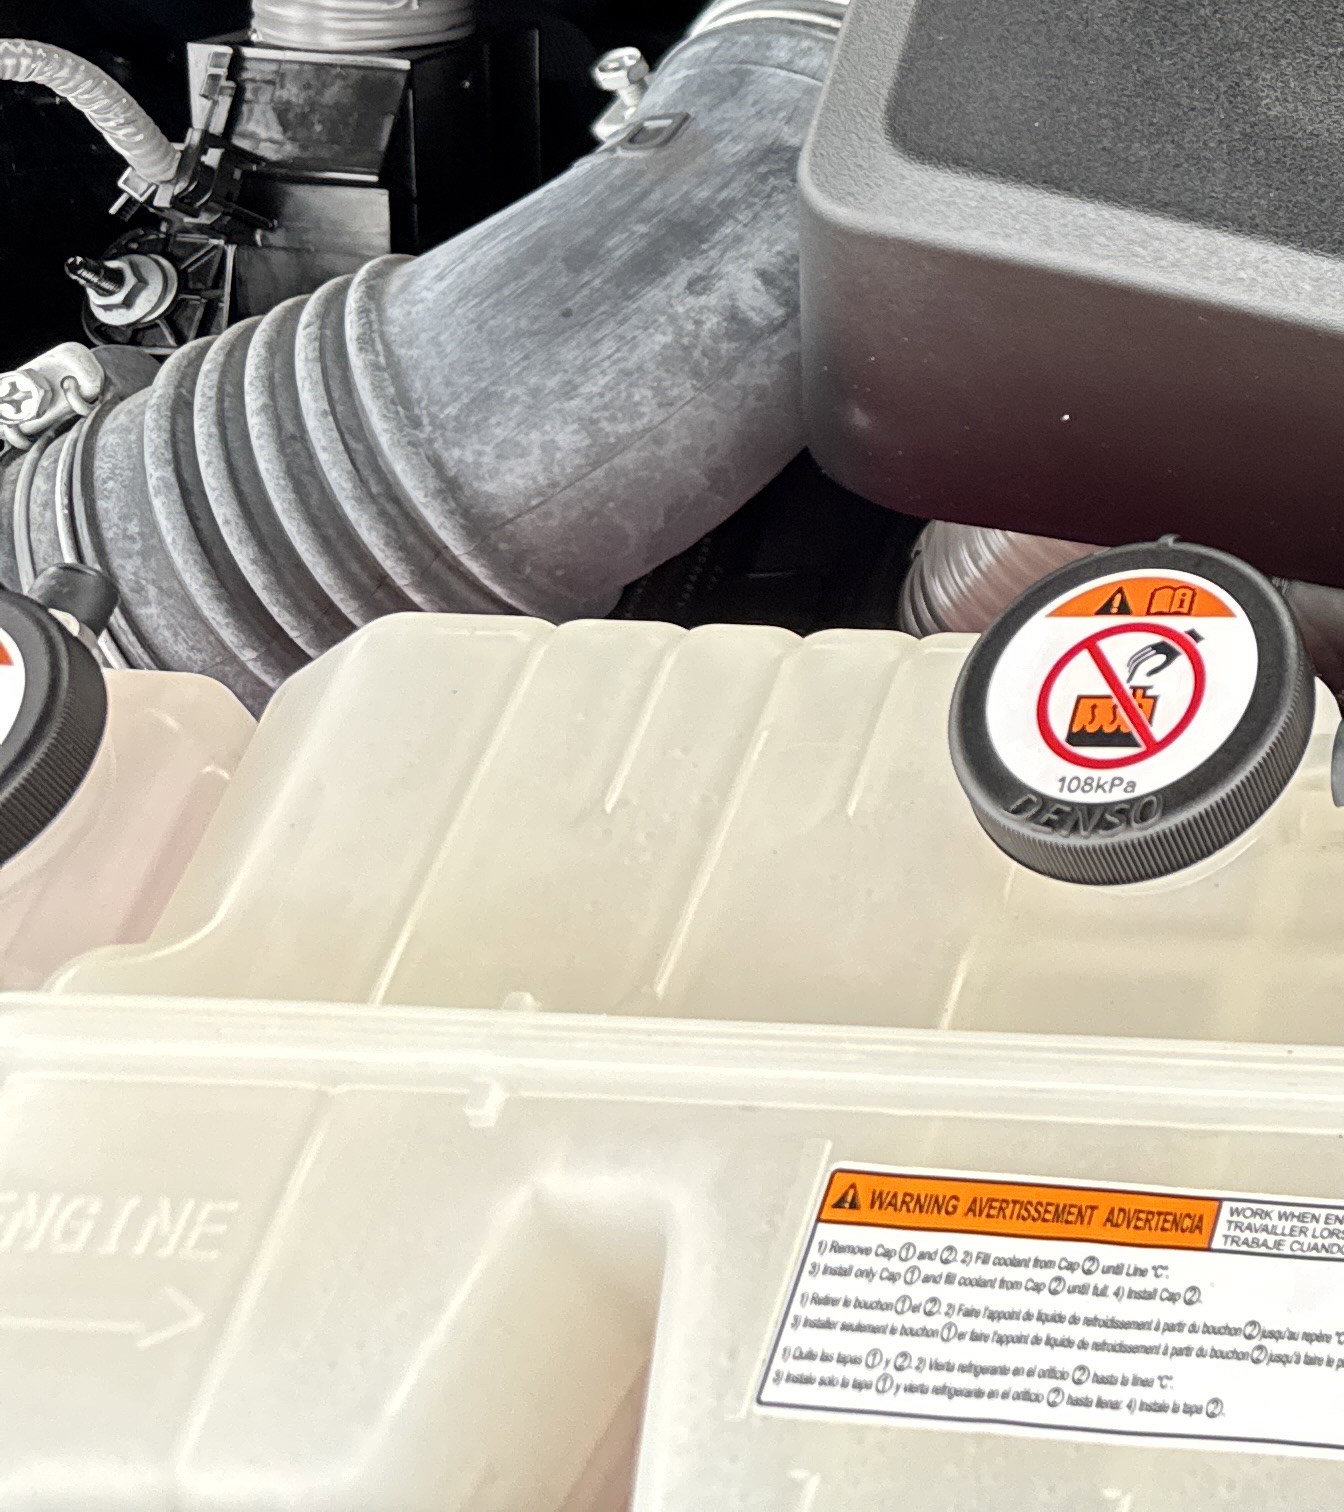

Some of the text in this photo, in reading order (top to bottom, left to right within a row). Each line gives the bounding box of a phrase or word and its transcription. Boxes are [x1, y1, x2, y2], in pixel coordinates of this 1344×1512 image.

[1057, 775, 1137, 795] 108kPa
[1002, 792, 1163, 839] DENSO
[869, 1189, 1204, 1234] WARNING AVERTISSEMENT ADVERTENCIA
[1229, 1206, 1273, 1221] WORK
[1277, 1210, 1321, 1224] WHEN
[1222, 1234, 1286, 1251] TRABAJE
[1226, 1219, 1309, 1238] TRAVAILLER
[828, 1240, 873, 1256] Remove
[874, 1243, 897, 1261] Cap
[916, 1249, 939, 1262] and
[974, 1251, 992, 1266] Fill
[992, 1255, 1032, 1269] coolant
[1032, 1256, 1057, 1270] from
[1057, 1256, 1081, 1274] Cap
[1101, 1262, 1125, 1276] until
[1125, 1264, 1149, 1278] Line
[821, 1264, 854, 1278] Install
[854, 1266, 877, 1283] only
[879, 1267, 902, 1284] Cap
[921, 1272, 943, 1285] and
[943, 1271, 957, 1286] fill
[957, 1276, 998, 1289] coolant
[998, 1277, 1023, 1291] from
[1024, 1277, 1047, 1295] Cap
[1066, 1282, 1091, 1296] until
[1126, 1287, 1159, 1301] Install
[1159, 1287, 1182, 1305] Cap
